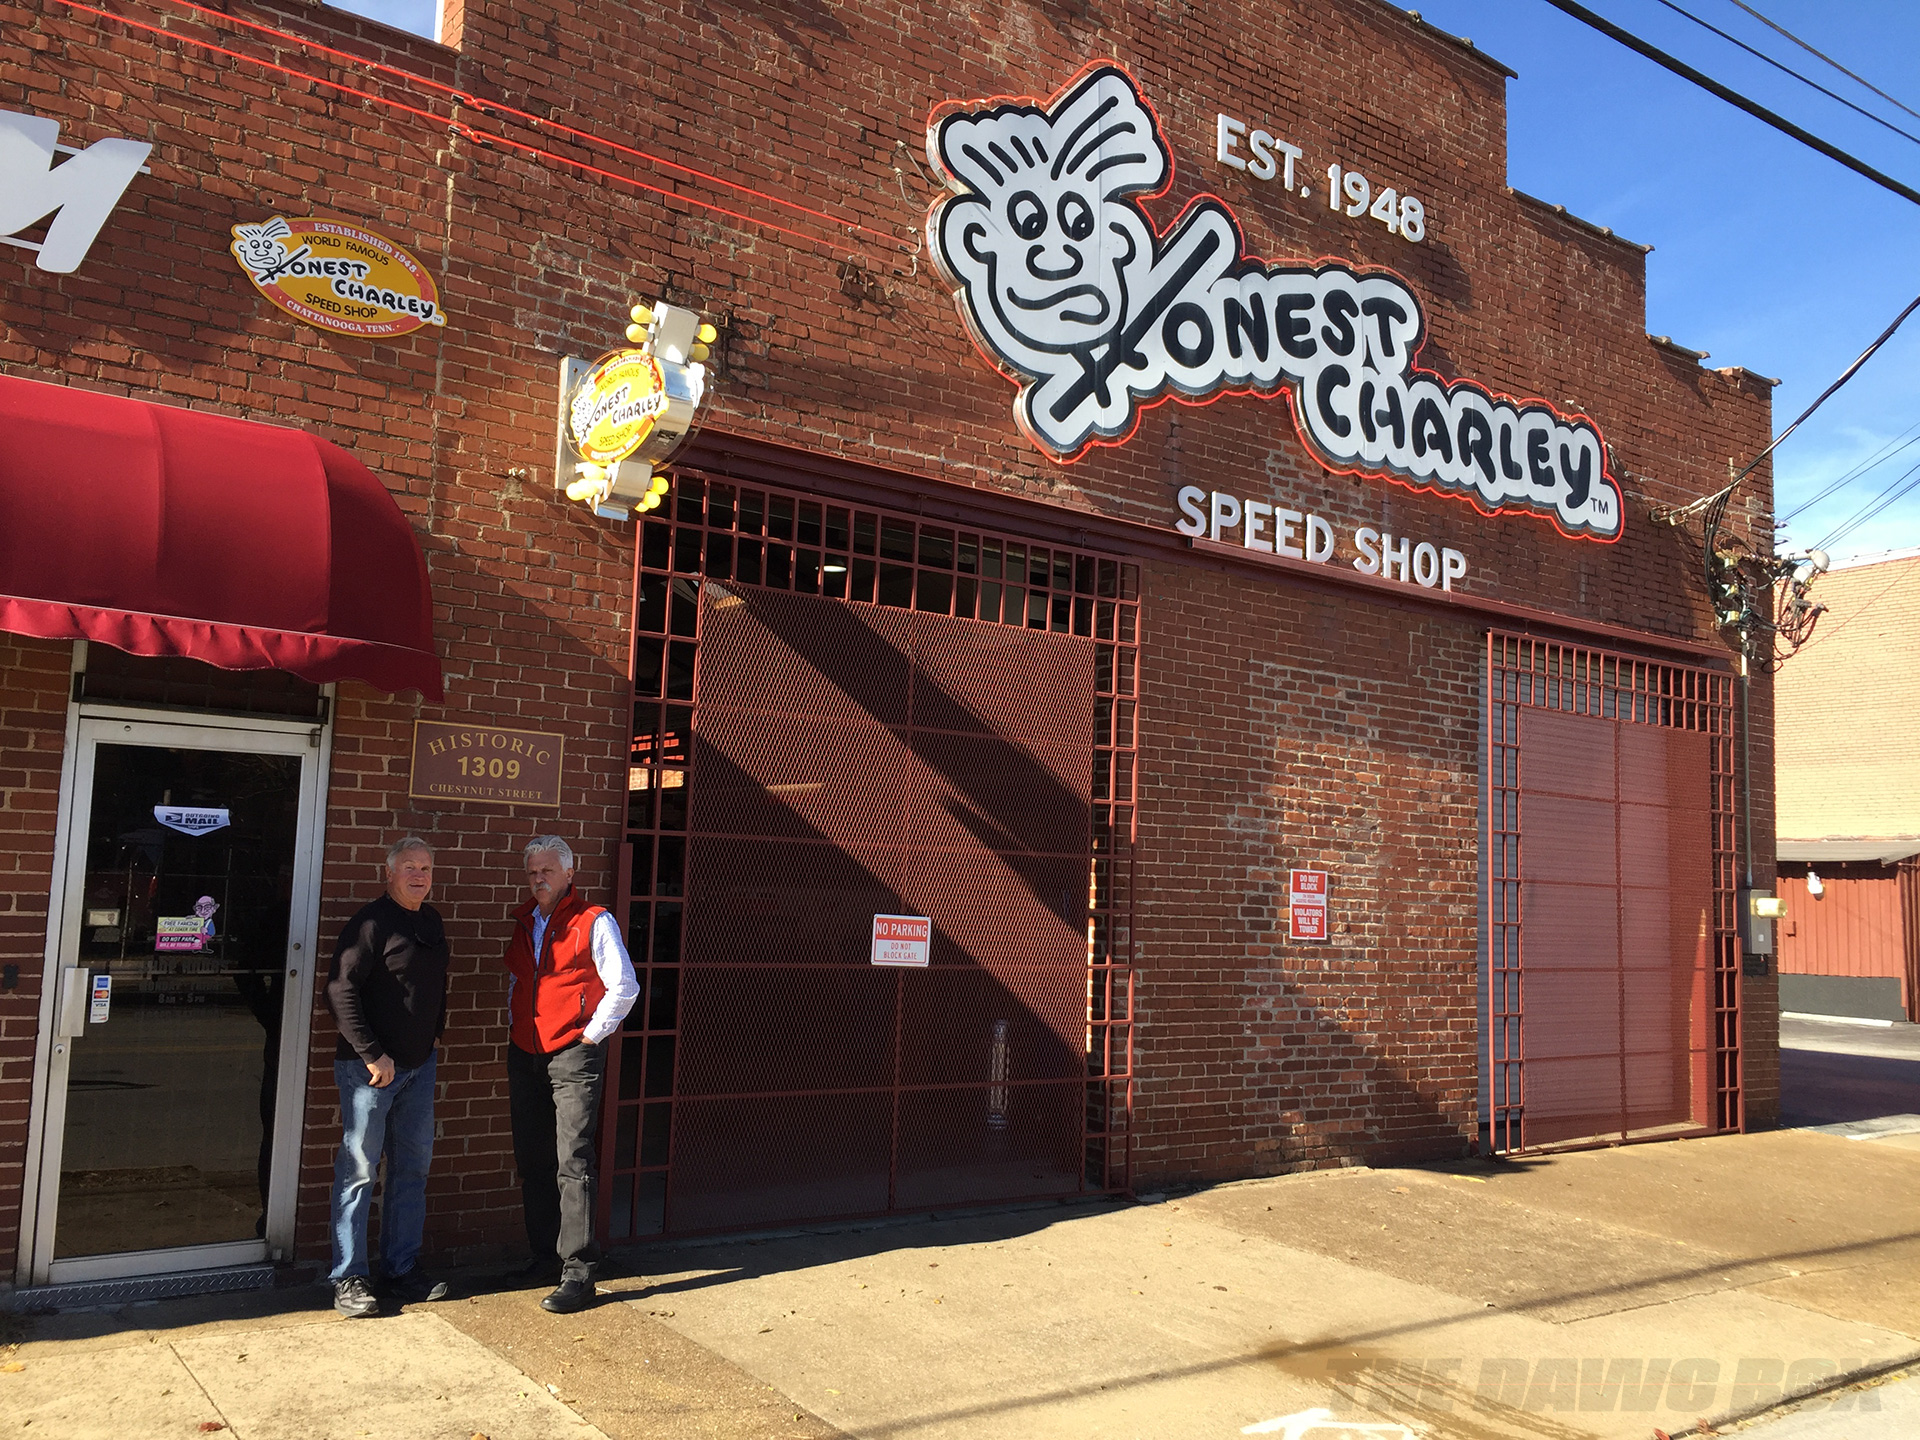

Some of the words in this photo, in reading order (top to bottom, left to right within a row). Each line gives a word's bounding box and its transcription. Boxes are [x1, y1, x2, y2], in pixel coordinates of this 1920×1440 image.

[1217, 113, 1311, 198] EST.
[1328, 163, 1426, 243] 1948
[302, 236, 341, 248] WORLD
[346, 241, 390, 266] FAMOUS
[313, 222, 393, 254] ESTABLISHED
[394, 251, 417, 273] 1948
[305, 293, 341, 313] SPEED
[344, 305, 378, 319] SHOP
[334, 279, 434, 319] CHARLEY
[286, 300, 365, 333] CHATTANOOGA,
[366, 324, 395, 333] TENN.
[1317, 363, 1593, 509] CHARLEY
[1590, 497, 1610, 515] TM
[1174, 484, 1335, 564] SPEED
[1352, 526, 1468, 593] SHOP
[428, 732, 550, 765] HISTORIC
[457, 756, 521, 780] 1309
[429, 783, 494, 796] CHESTNUT
[498, 788, 543, 800] STREET
[1300, 883, 1318, 891] BLOCK
[1308, 875, 1319, 883] NOT
[876, 922, 889, 935] NO
[890, 923, 928, 938] PARKING
[1297, 917, 1310, 925] WILL
[883, 951, 903, 959] BLOCK
[903, 952, 917, 960] GATE
[890, 942, 899, 950] DO
